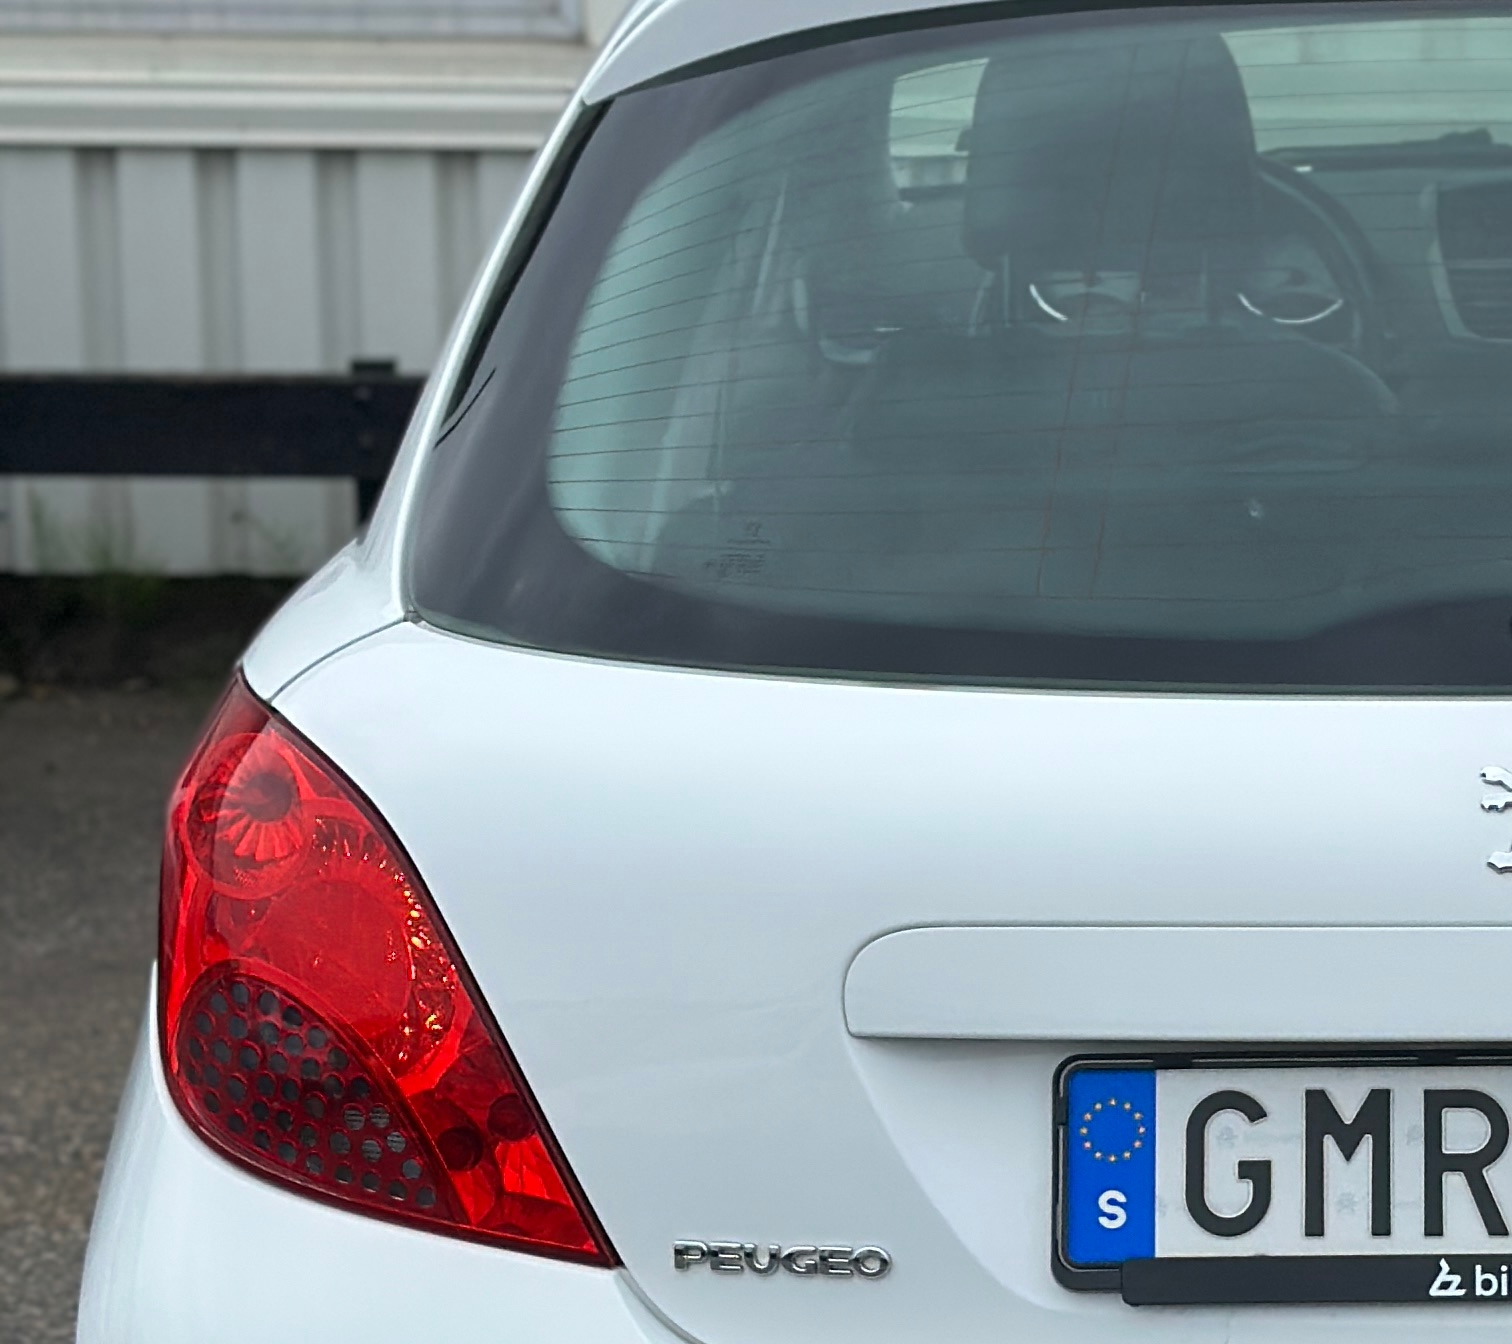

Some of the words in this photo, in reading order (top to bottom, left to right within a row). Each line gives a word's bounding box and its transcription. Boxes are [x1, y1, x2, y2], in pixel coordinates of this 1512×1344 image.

[1183, 1087, 1511, 1239] GMR
[1097, 1189, 1128, 1230] S
[673, 1239, 893, 1279] PEUGEO
